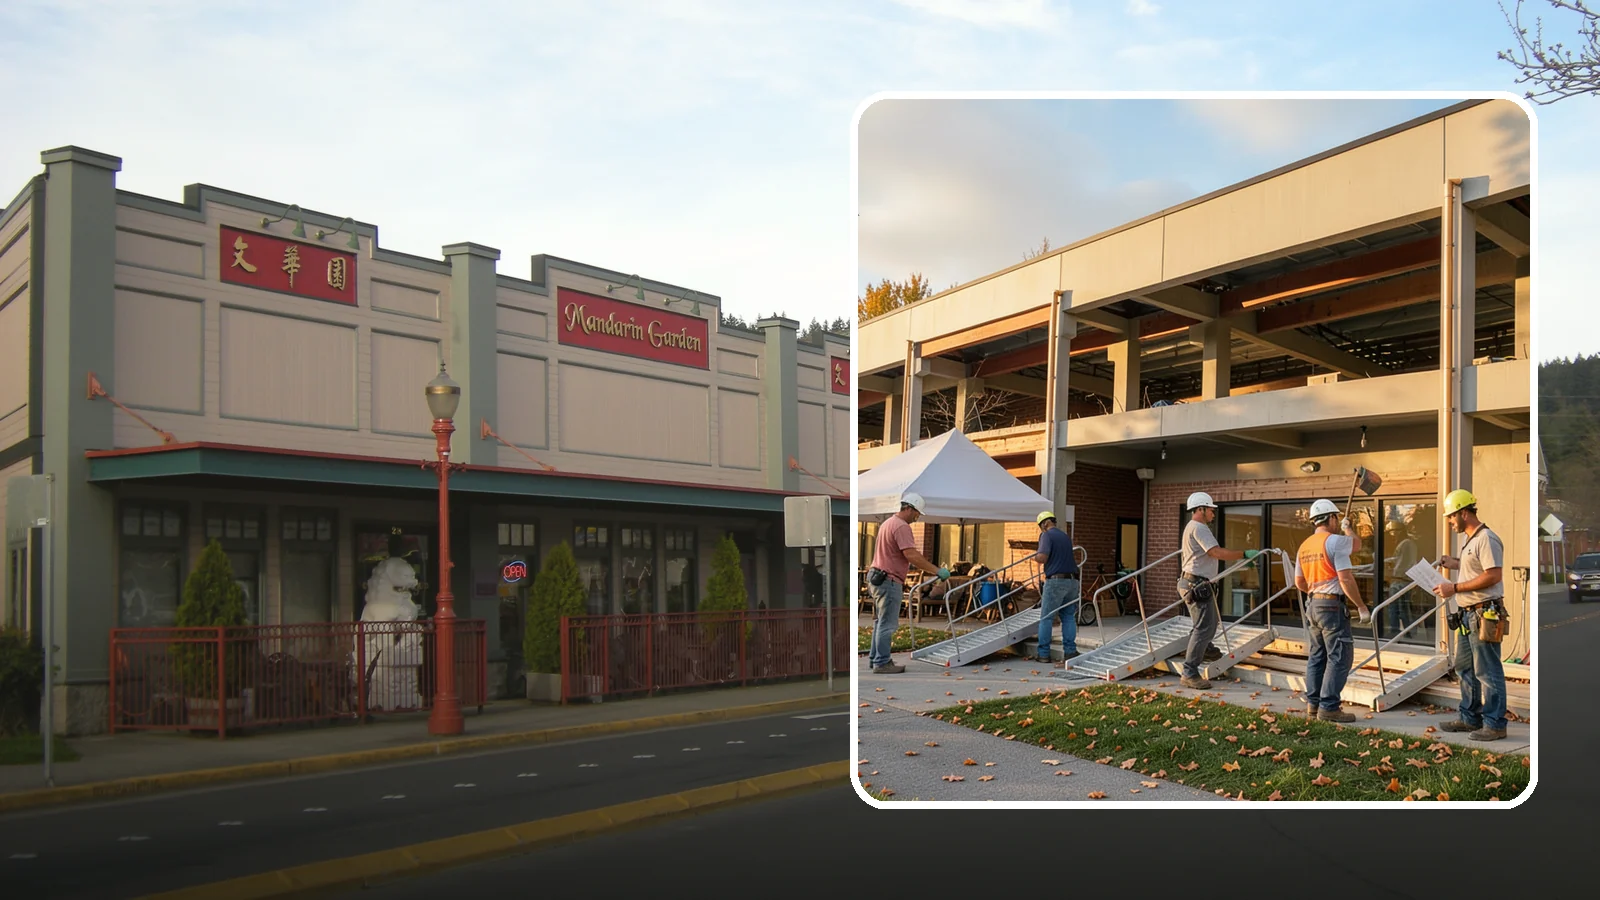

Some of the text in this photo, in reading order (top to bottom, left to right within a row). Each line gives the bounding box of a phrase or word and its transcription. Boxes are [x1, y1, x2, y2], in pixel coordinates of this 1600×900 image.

[230, 235, 346, 291] 文華園
[564, 302, 702, 352] Mandarin Garden
[503, 565, 527, 578] OPEN
